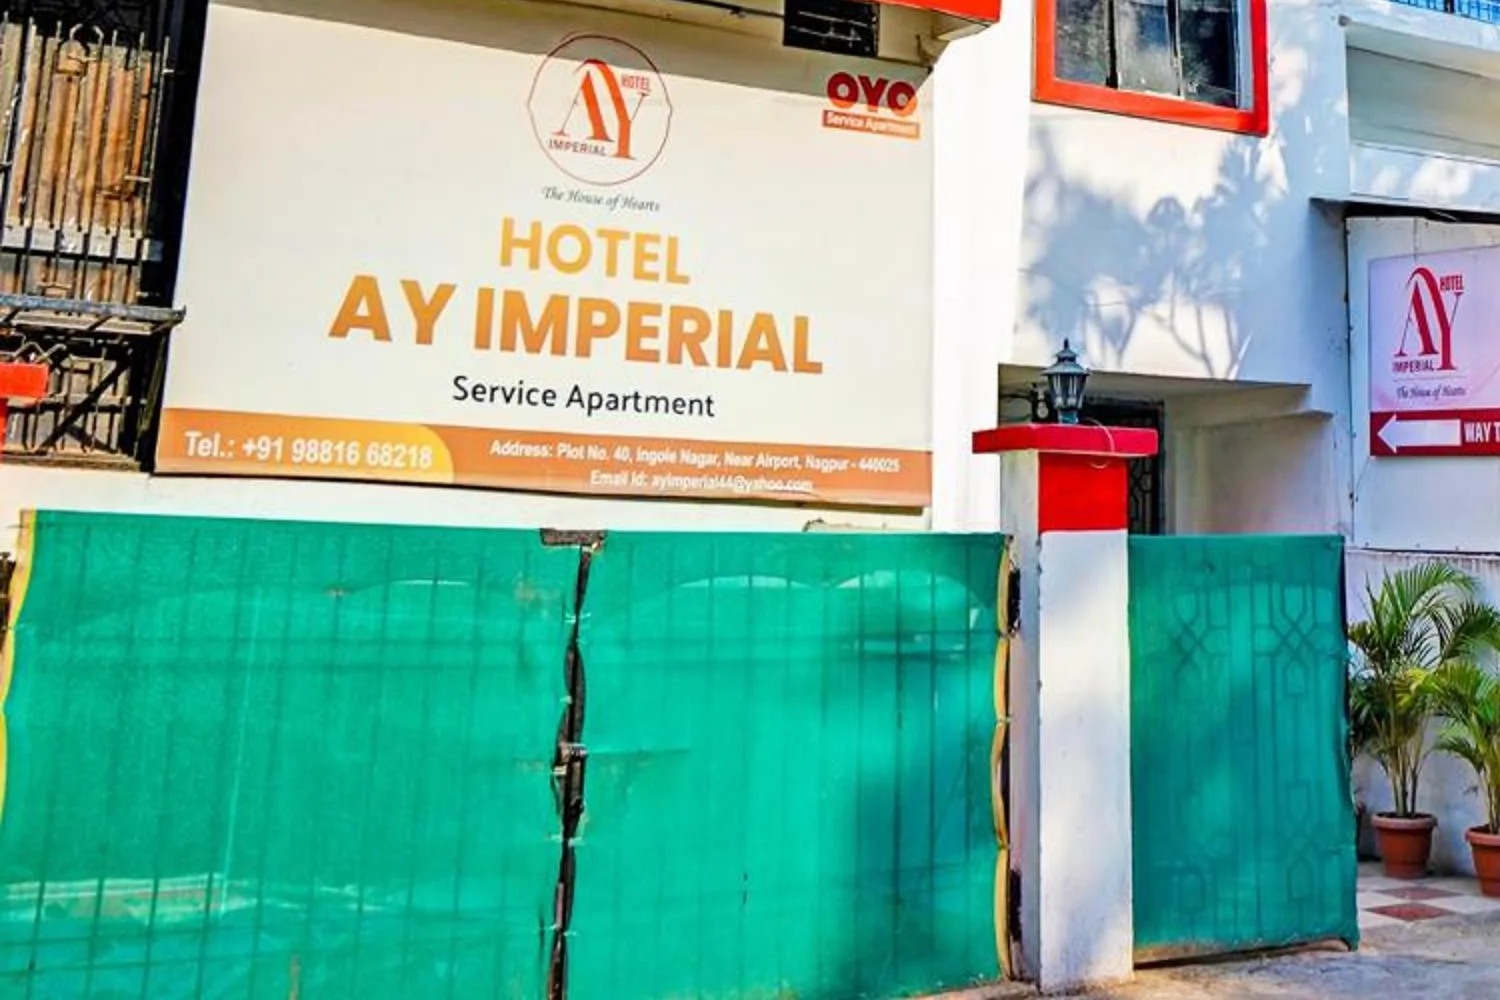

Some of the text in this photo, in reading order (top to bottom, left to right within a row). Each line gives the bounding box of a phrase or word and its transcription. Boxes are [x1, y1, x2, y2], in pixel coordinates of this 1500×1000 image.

[621, 74, 652, 91] HOTEL
[827, 71, 917, 117] OYO
[548, 139, 607, 157] IMPERIAL
[543, 186, 660, 212] The House of Hearts
[499, 216, 690, 285] HOTEL
[1439, 274, 1464, 291] HOTEL
[328, 274, 823, 375] AY IMPERIAL
[1392, 359, 1435, 373] IMPERIAL
[452, 375, 715, 418] Service Apartment
[1463, 421, 1492, 443] WAY
[184, 431, 433, 470] Tel.: +91 98816 68218
[490, 440, 553, 458] Address:
[556, 442, 585, 460] Plot
[587, 444, 610, 461] No.
[613, 446, 634, 464] 40,
[679, 449, 721, 469] Nagar,
[723, 451, 755, 468] Near
[755, 452, 803, 471] Airport,
[804, 454, 850, 474] Nagpur
[590, 468, 628, 486] Email
